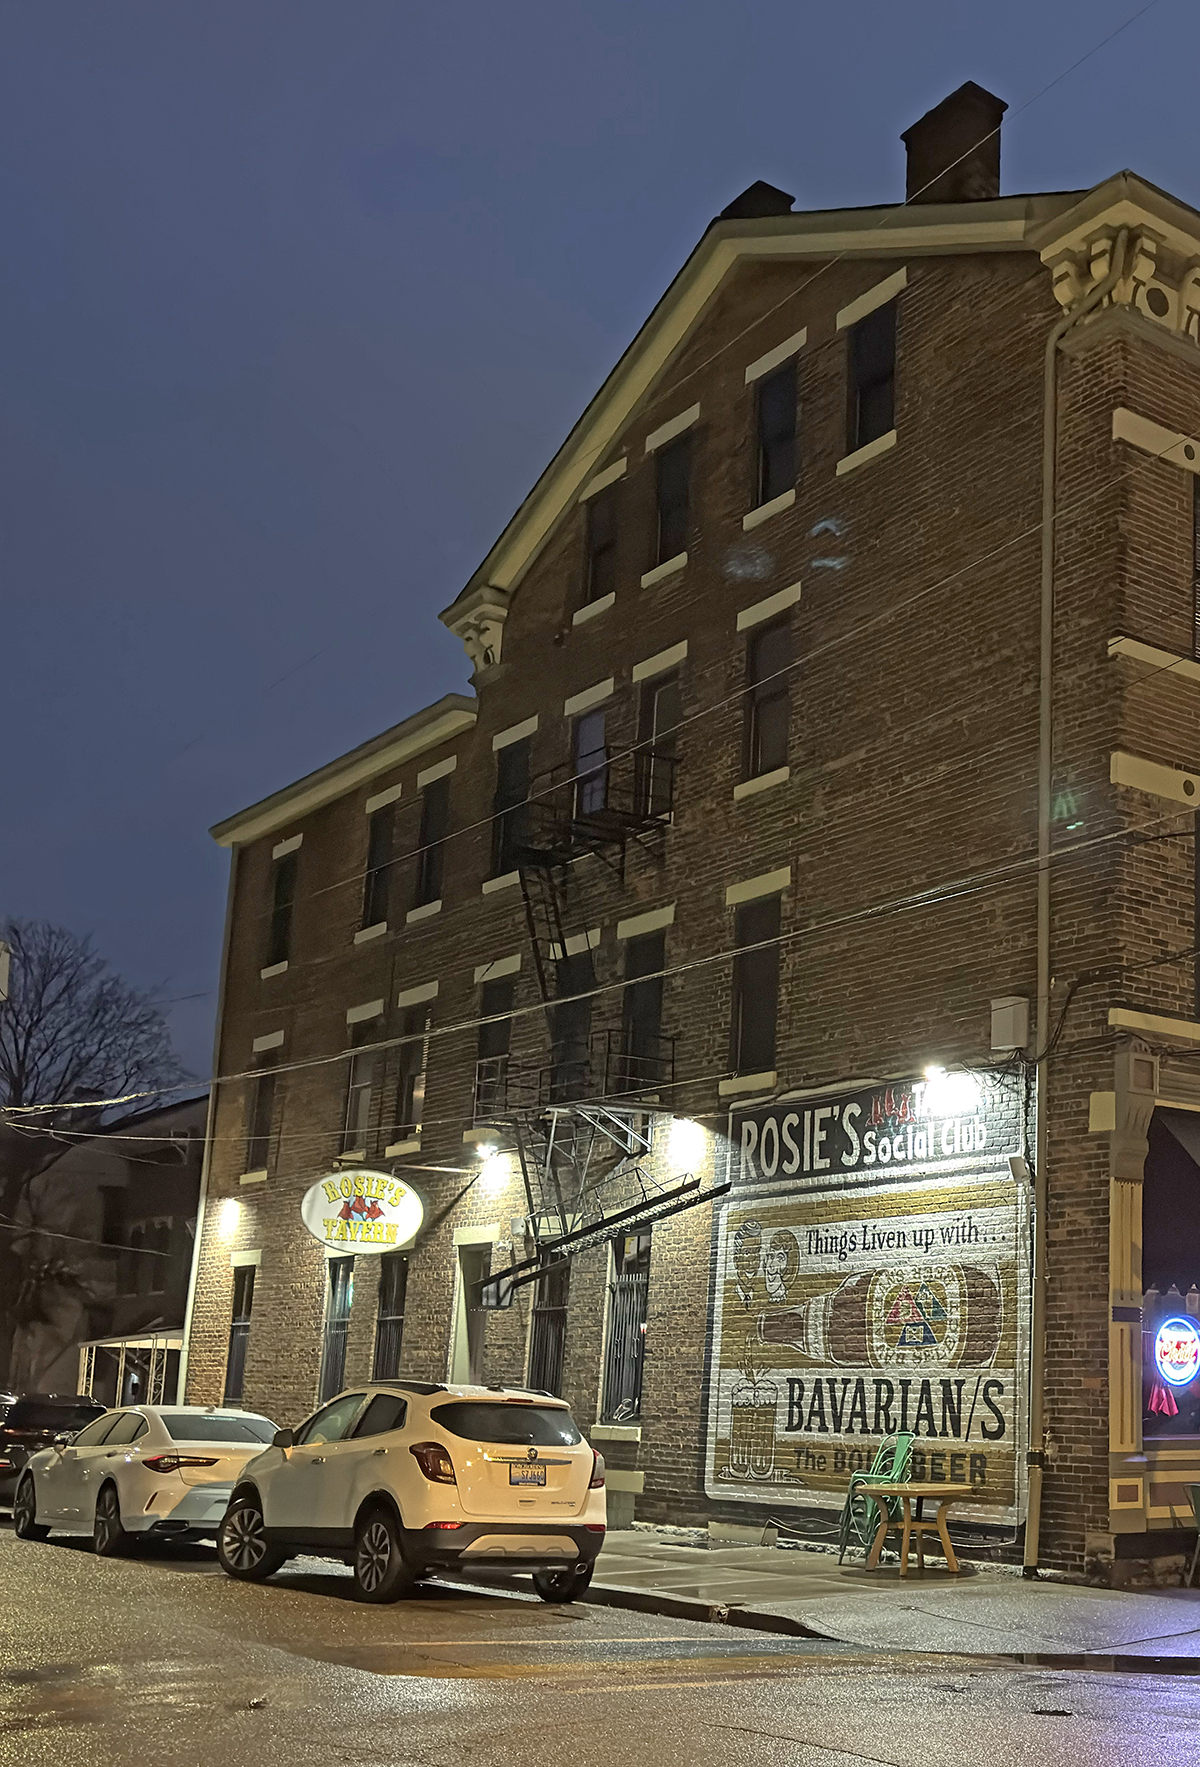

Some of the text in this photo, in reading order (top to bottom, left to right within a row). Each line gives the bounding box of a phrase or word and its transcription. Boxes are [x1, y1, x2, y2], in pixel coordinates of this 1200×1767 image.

[740, 1102, 862, 1180] ROSIE'S
[941, 1115, 987, 1155] Club
[322, 1176, 407, 1207] ROSIE'S
[322, 1218, 399, 1244] TAVERN
[805, 1228, 857, 1261] Things
[861, 1224, 907, 1251] Liven
[912, 1228, 935, 1253] up
[794, 1447, 827, 1471] The
[910, 1450, 987, 1484] BEER
